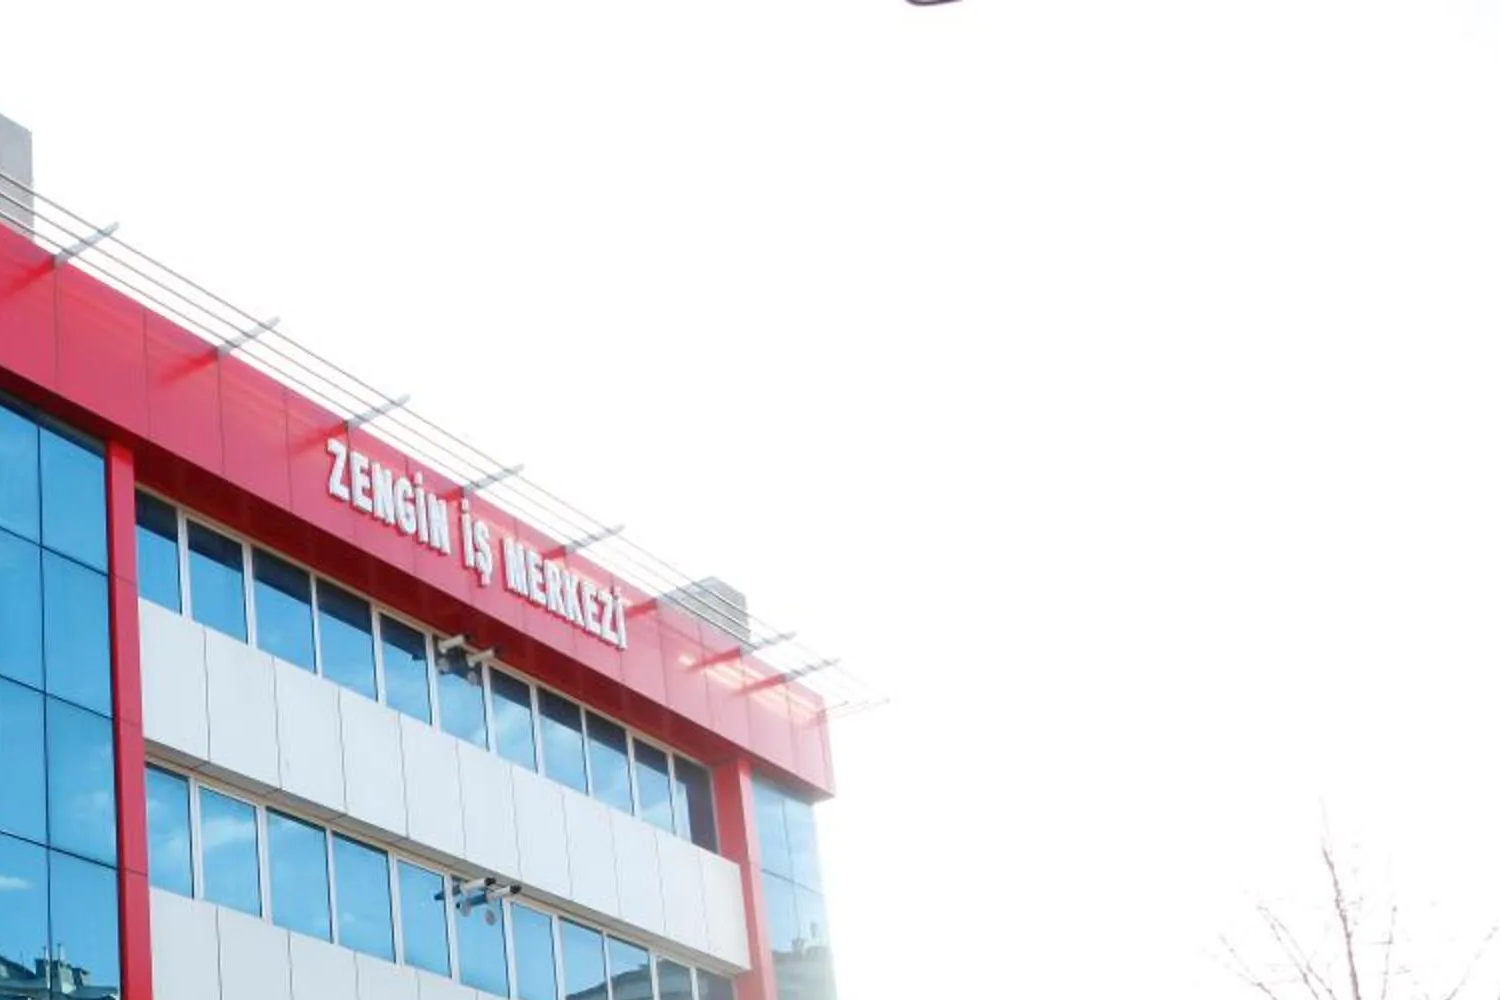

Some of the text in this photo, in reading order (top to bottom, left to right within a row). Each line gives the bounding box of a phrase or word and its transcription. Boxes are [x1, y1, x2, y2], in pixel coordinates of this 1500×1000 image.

[325, 437, 629, 651] ZENGİN İŞ MERKEZİ
